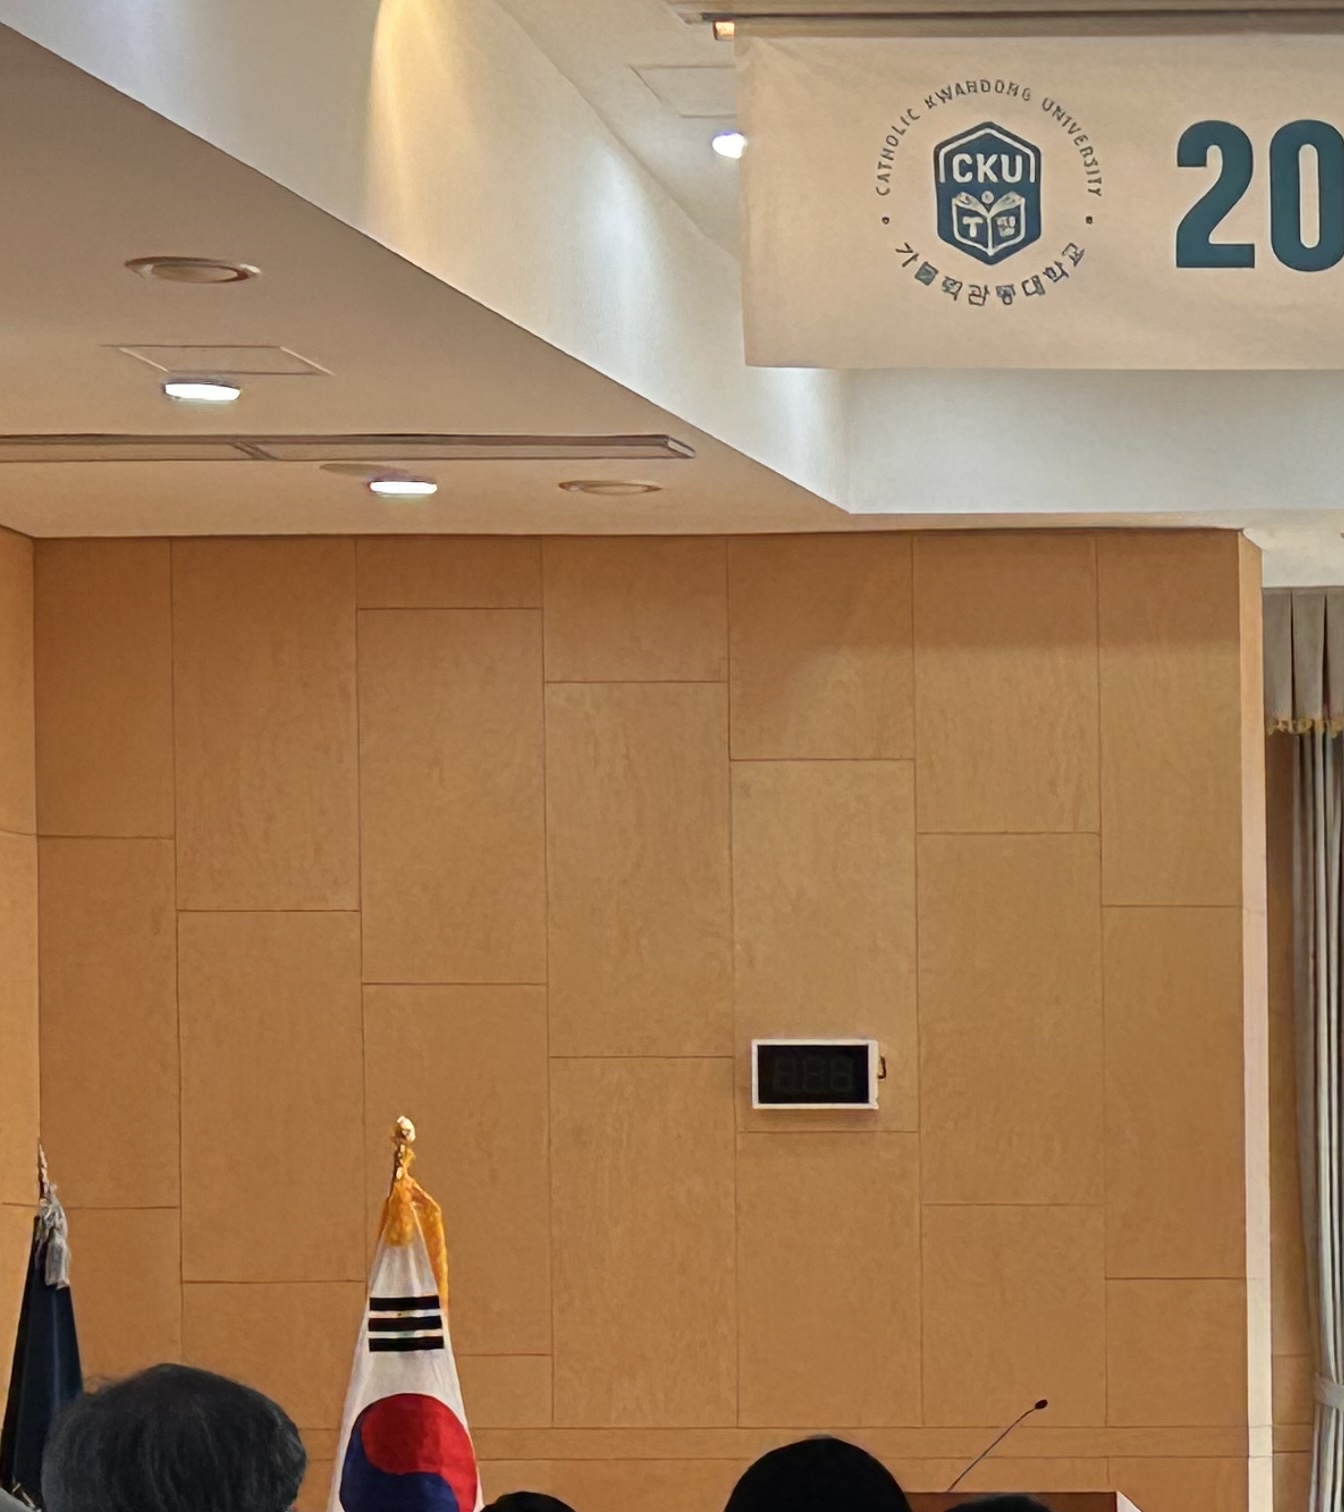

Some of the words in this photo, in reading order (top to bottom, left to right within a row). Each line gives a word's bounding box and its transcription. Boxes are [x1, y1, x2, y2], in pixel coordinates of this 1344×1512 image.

[876, 108, 921, 197] CATHOLIC
[1041, 97, 1103, 197] UNIVERSITY
[952, 153, 1023, 183] CKU
